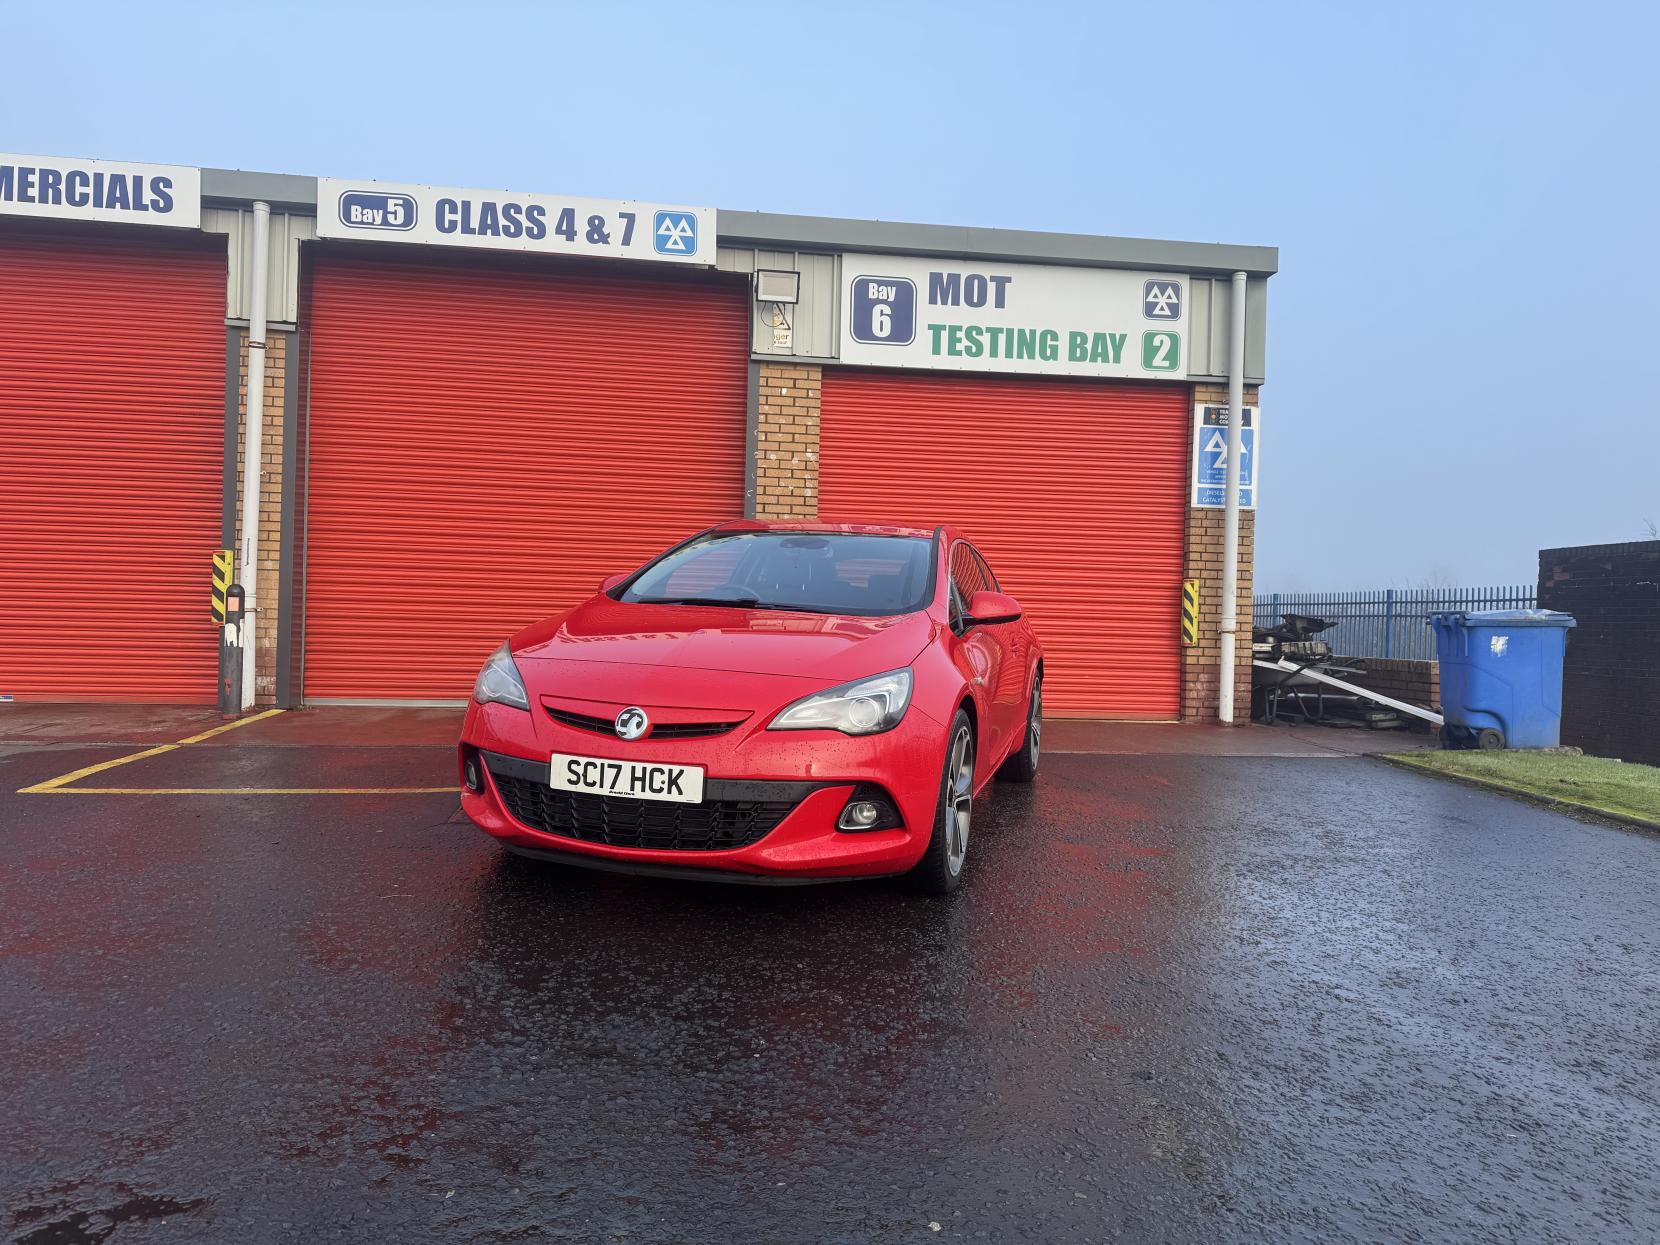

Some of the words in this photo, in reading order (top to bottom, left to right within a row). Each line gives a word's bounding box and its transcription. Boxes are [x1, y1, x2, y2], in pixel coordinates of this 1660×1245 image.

[350, 206, 383, 225] Bay
[386, 198, 405, 225] 5
[435, 198, 547, 241] CLASS
[554, 207, 578, 241] 4
[585, 214, 611, 245] &
[618, 212, 636, 247] 7
[869, 282, 896, 302] Bay
[928, 271, 1012, 309] MOT
[873, 304, 892, 338] 6
[927, 323, 1060, 361] TESTING
[1067, 330, 1127, 364] BAY
[1151, 334, 1171, 367] 2
[567, 759, 623, 790] SC17
[630, 766, 685, 796] HCK
